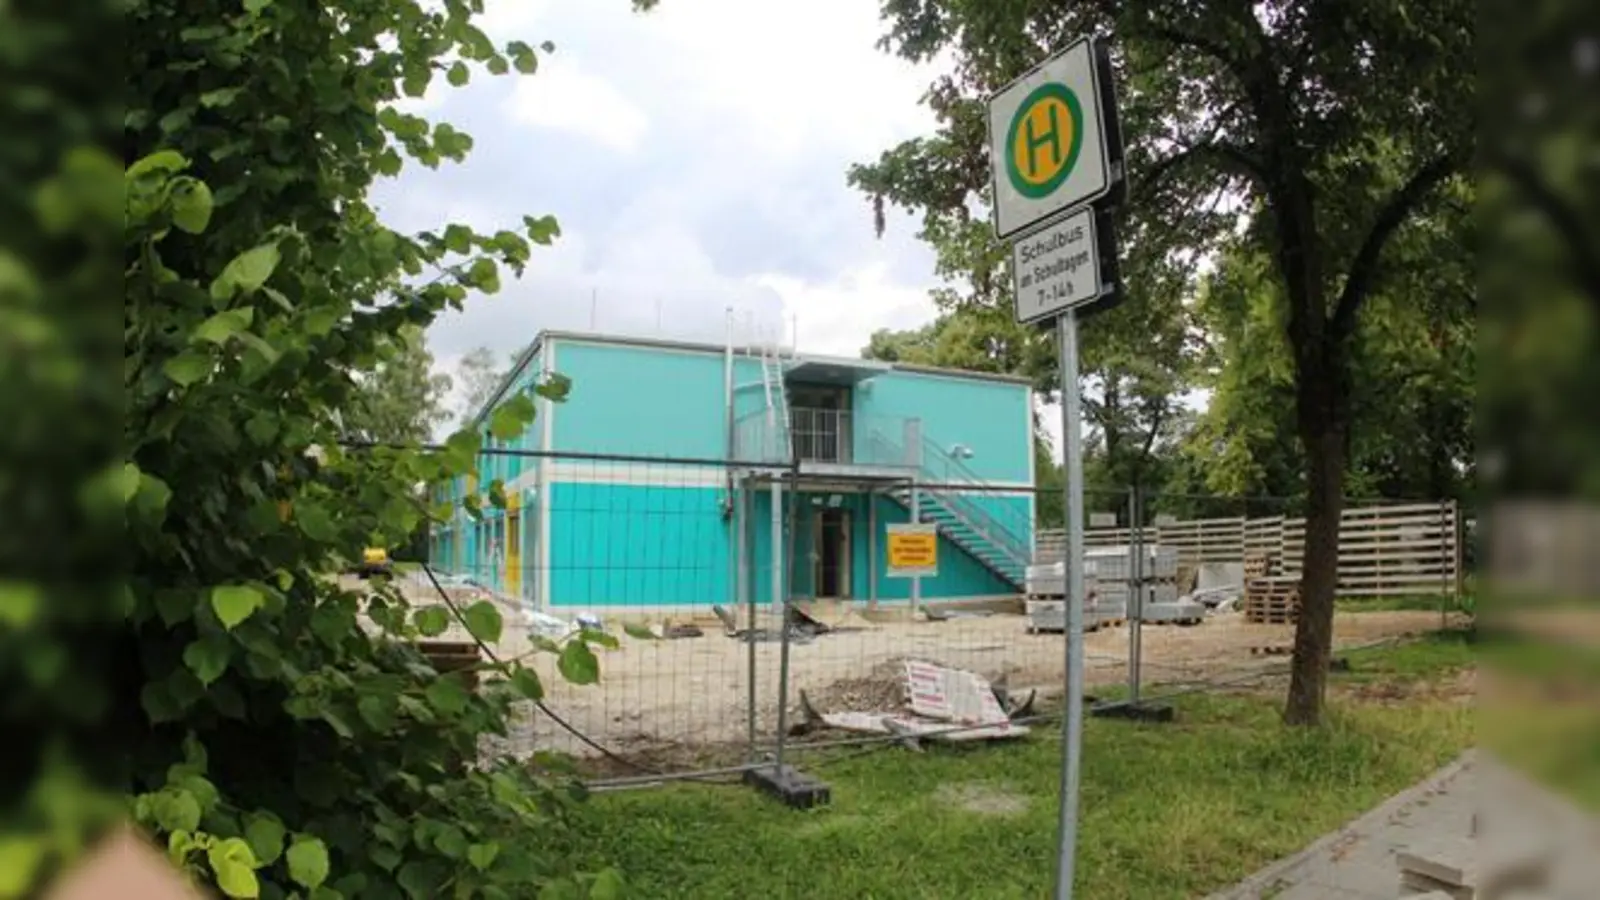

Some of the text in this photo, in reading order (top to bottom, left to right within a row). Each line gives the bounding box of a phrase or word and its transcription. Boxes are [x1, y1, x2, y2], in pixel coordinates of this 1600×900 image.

[1026, 102, 1061, 177] H
[1021, 225, 1083, 264] Schulbus
[1034, 250, 1089, 283] Schultagen
